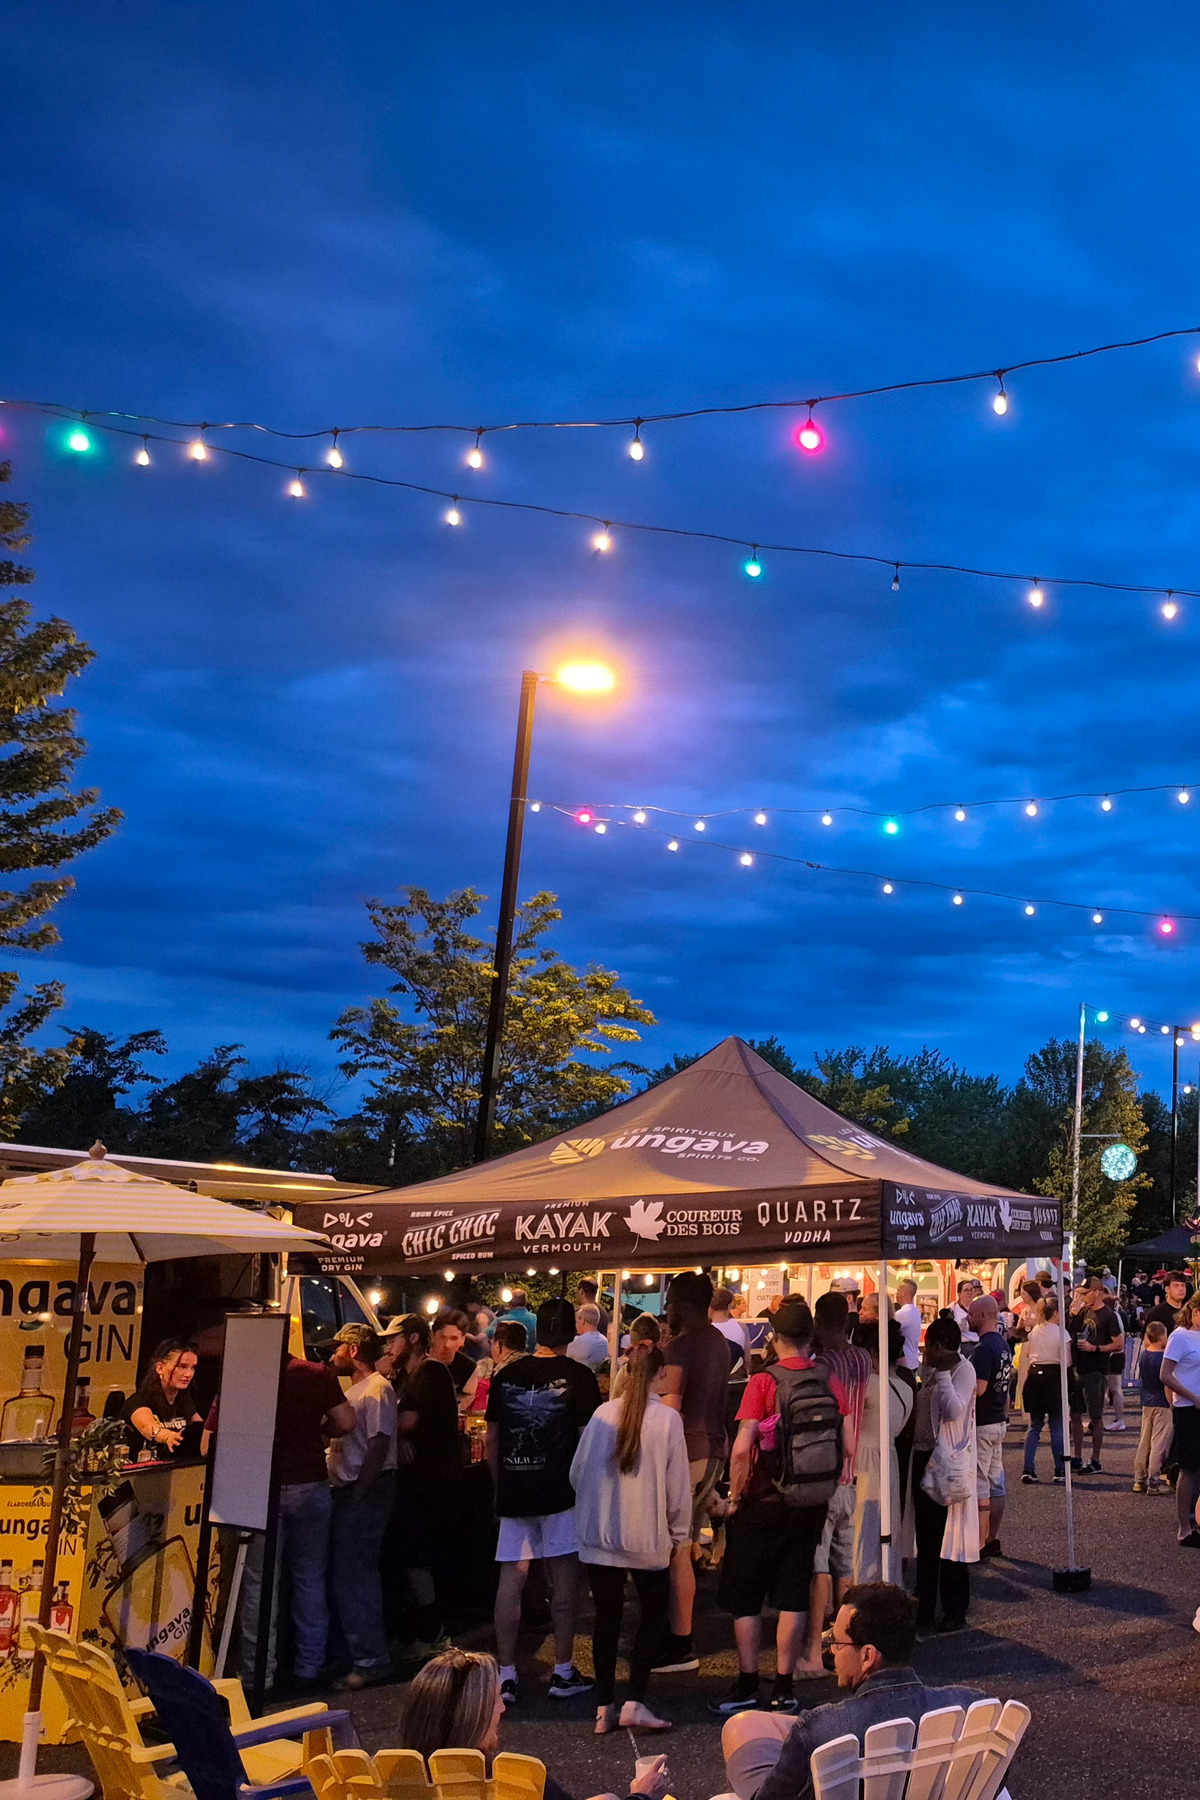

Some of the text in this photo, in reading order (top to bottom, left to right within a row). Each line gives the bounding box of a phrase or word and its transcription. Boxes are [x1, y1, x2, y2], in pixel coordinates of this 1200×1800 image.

[623, 1126, 737, 1139] LES SPIRITUEUX
[610, 1134, 769, 1154] ungava
[677, 1153, 732, 1161] SPIRITS
[544, 1201, 589, 1210] PREMIUM
[757, 1198, 862, 1227] QUARTZ
[666, 1209, 743, 1223] COUREUR
[890, 1210, 925, 1231] ungava
[966, 1204, 997, 1228] KAYAK
[515, 1211, 612, 1240] KAYAK
[666, 1222, 741, 1236] DES BOIS
[401, 1212, 500, 1256] CHIC CHOC
[784, 1229, 831, 1244] VODKA
[971, 1231, 995, 1240] VERMOUTH
[522, 1242, 601, 1254] VERMOUTH
[317, 1256, 365, 1264] PREMIUM
[451, 1251, 494, 1260] SPICED RUM
[64, 1324, 134, 1364] GIN
